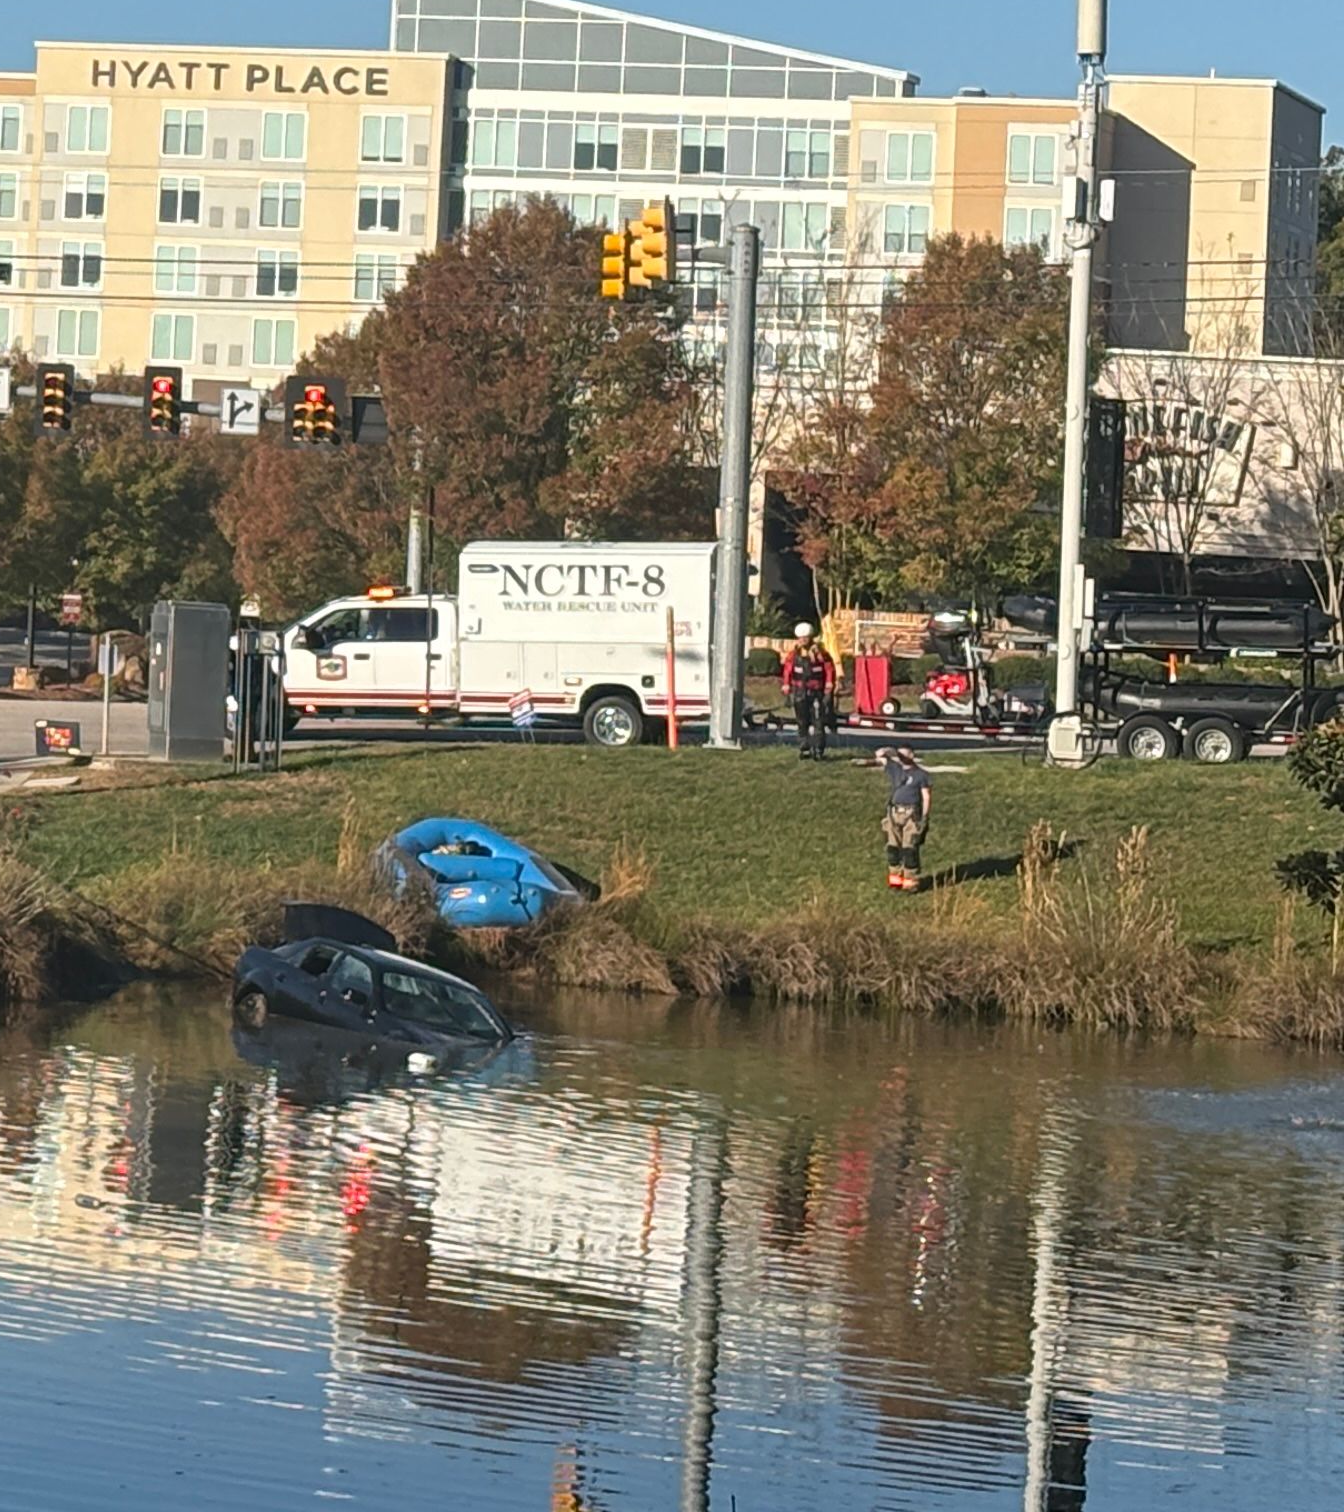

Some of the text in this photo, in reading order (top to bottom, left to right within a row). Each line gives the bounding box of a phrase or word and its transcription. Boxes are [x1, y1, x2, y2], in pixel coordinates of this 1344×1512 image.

[91, 59, 390, 97] HYATT PLACE
[498, 563, 666, 598] NCTF-8
[502, 600, 659, 614] WATER RESCUE UNIT
